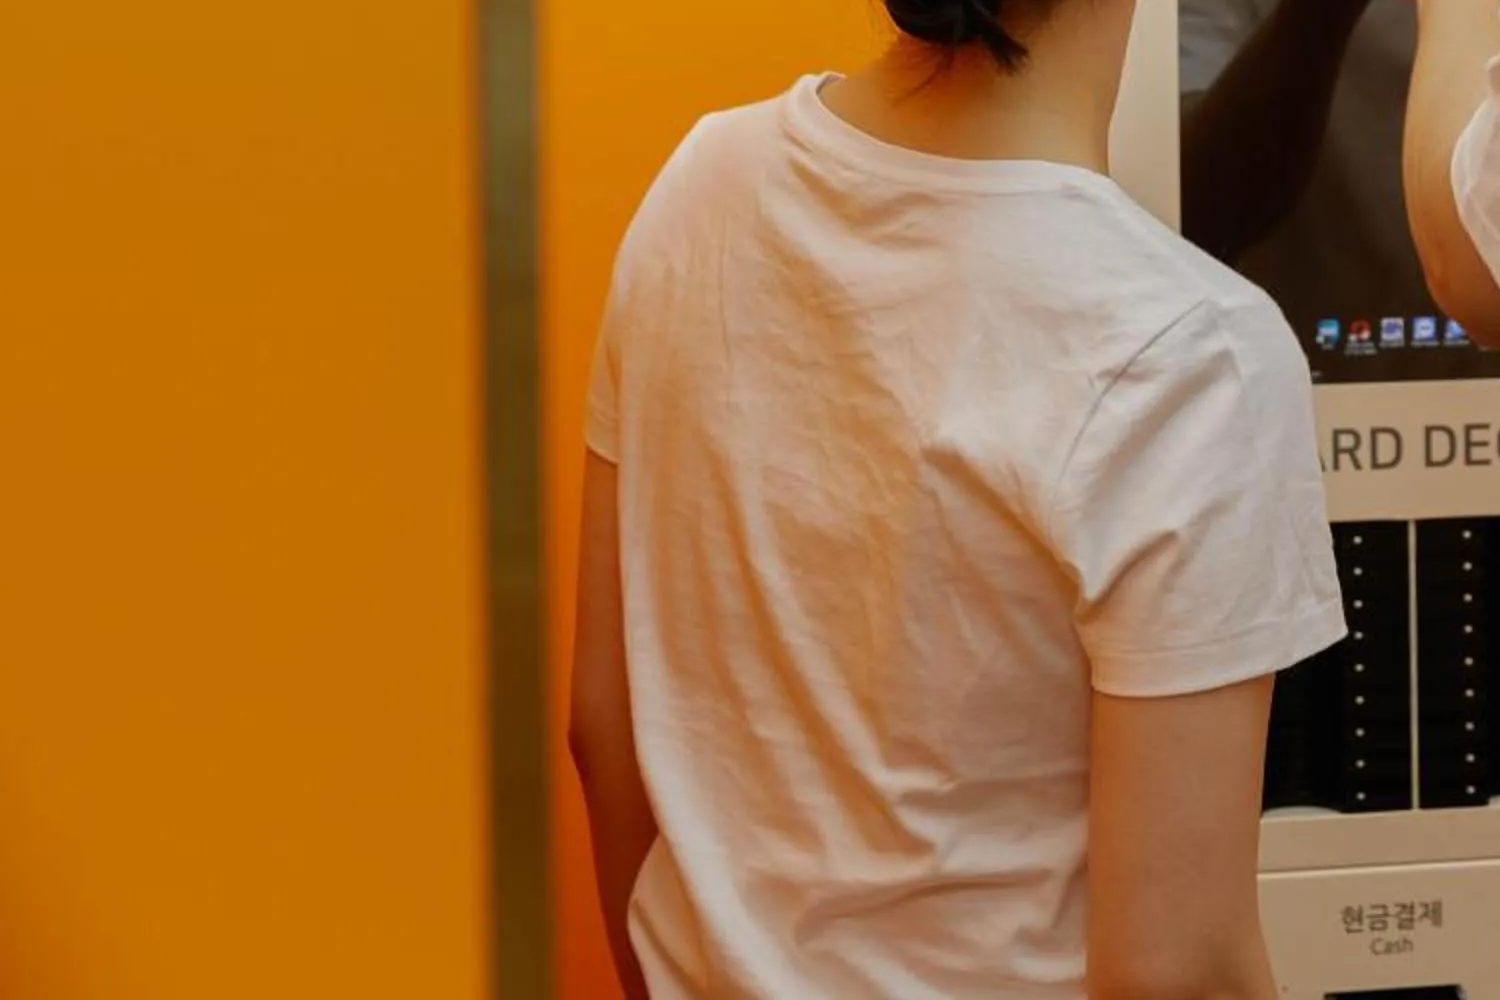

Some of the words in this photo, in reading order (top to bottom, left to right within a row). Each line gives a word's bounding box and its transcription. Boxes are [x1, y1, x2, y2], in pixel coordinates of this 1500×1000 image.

[1318, 427, 1404, 473] RD
[1339, 900, 1443, 934] 현금결제
[1369, 937, 1414, 956] Cash
